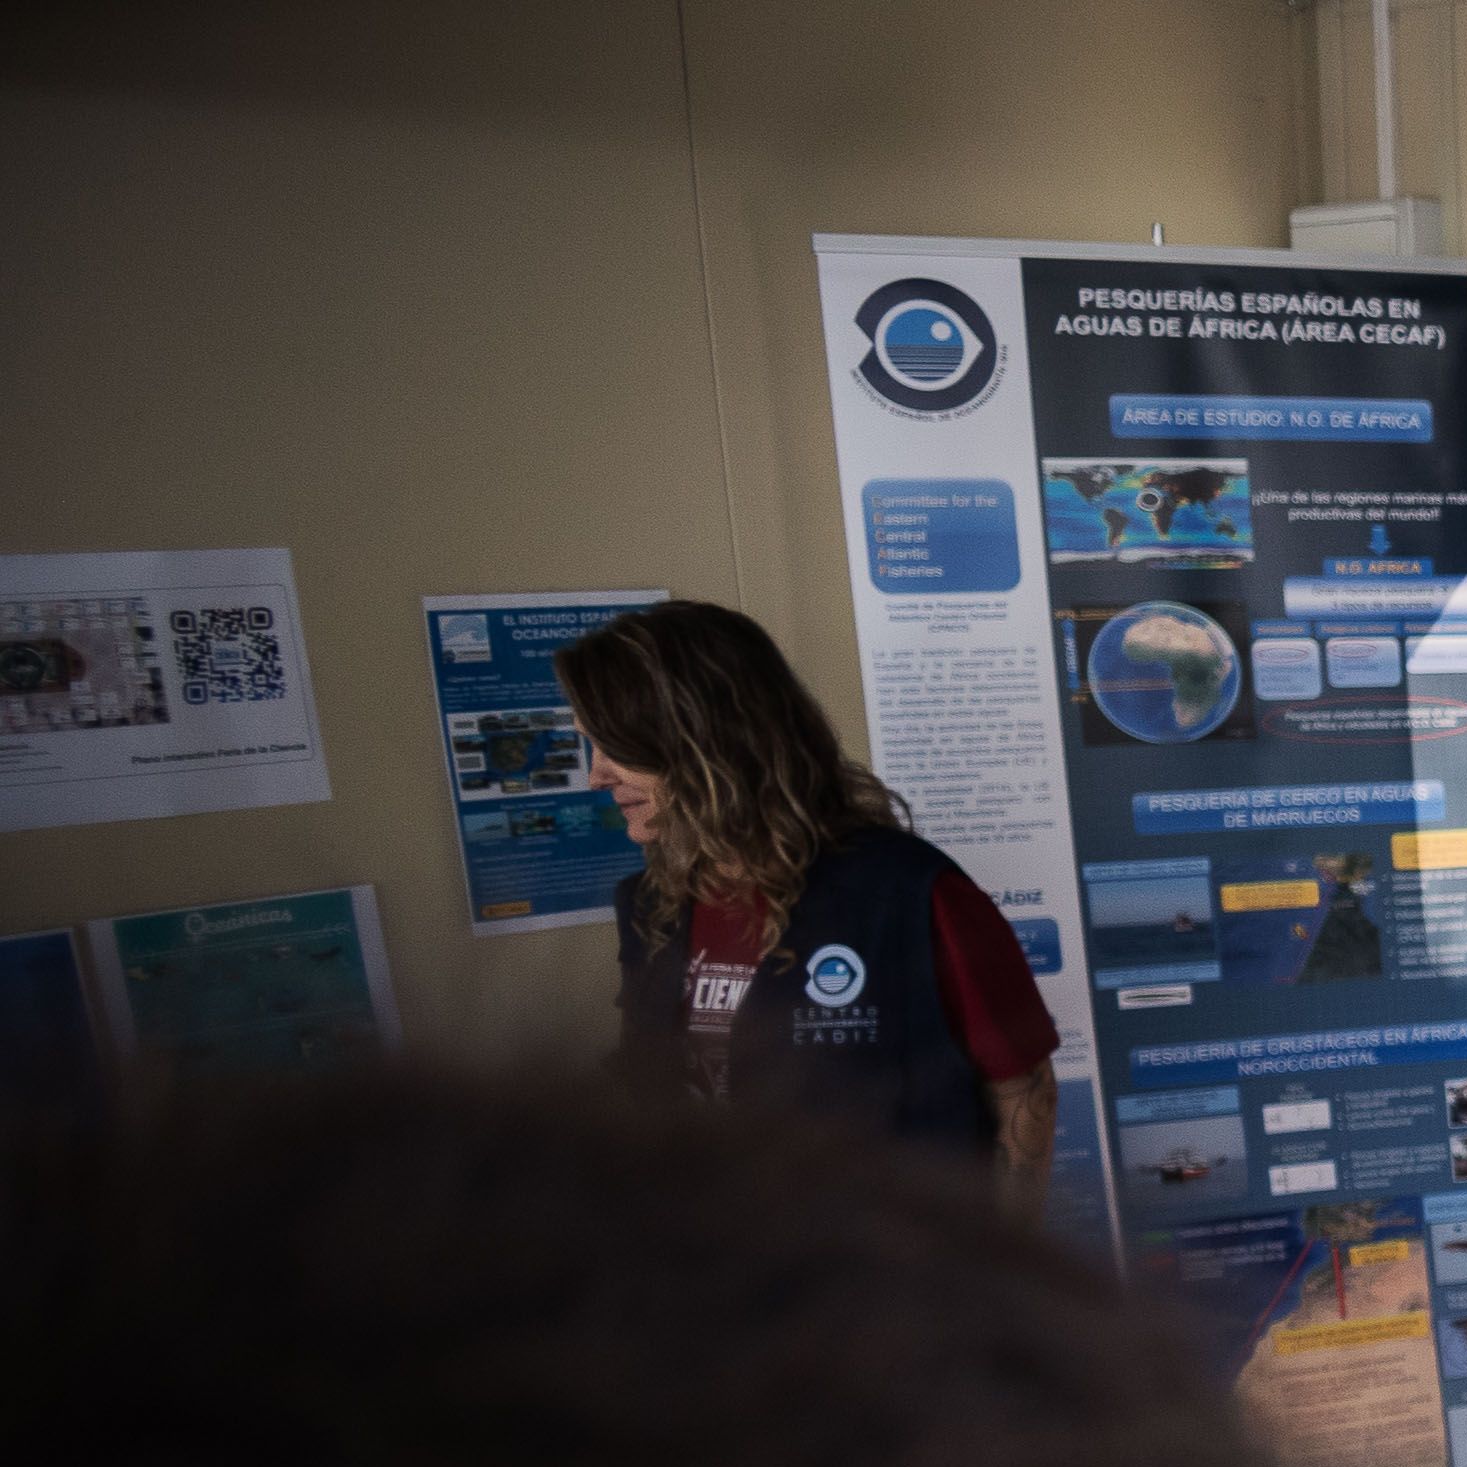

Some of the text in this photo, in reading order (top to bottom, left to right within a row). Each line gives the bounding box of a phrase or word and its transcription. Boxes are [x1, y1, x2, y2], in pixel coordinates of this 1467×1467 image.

[1079, 287, 1420, 319] PESQUERÍAS ESPAÑOLAS EN
[1055, 314, 1445, 349] AGUAS DE ÁFRICA (ÁREA CECAF)
[1176, 410, 1199, 425] DE
[1330, 413, 1354, 428] DE
[1253, 789, 1273, 805] DE
[1278, 786, 1341, 805] CERCO
[1345, 786, 1366, 803] EN
[1371, 784, 1429, 801] AGUAS
[1224, 808, 1360, 828] DE MARRUECOS
[693, 978, 750, 1009] CIEN
